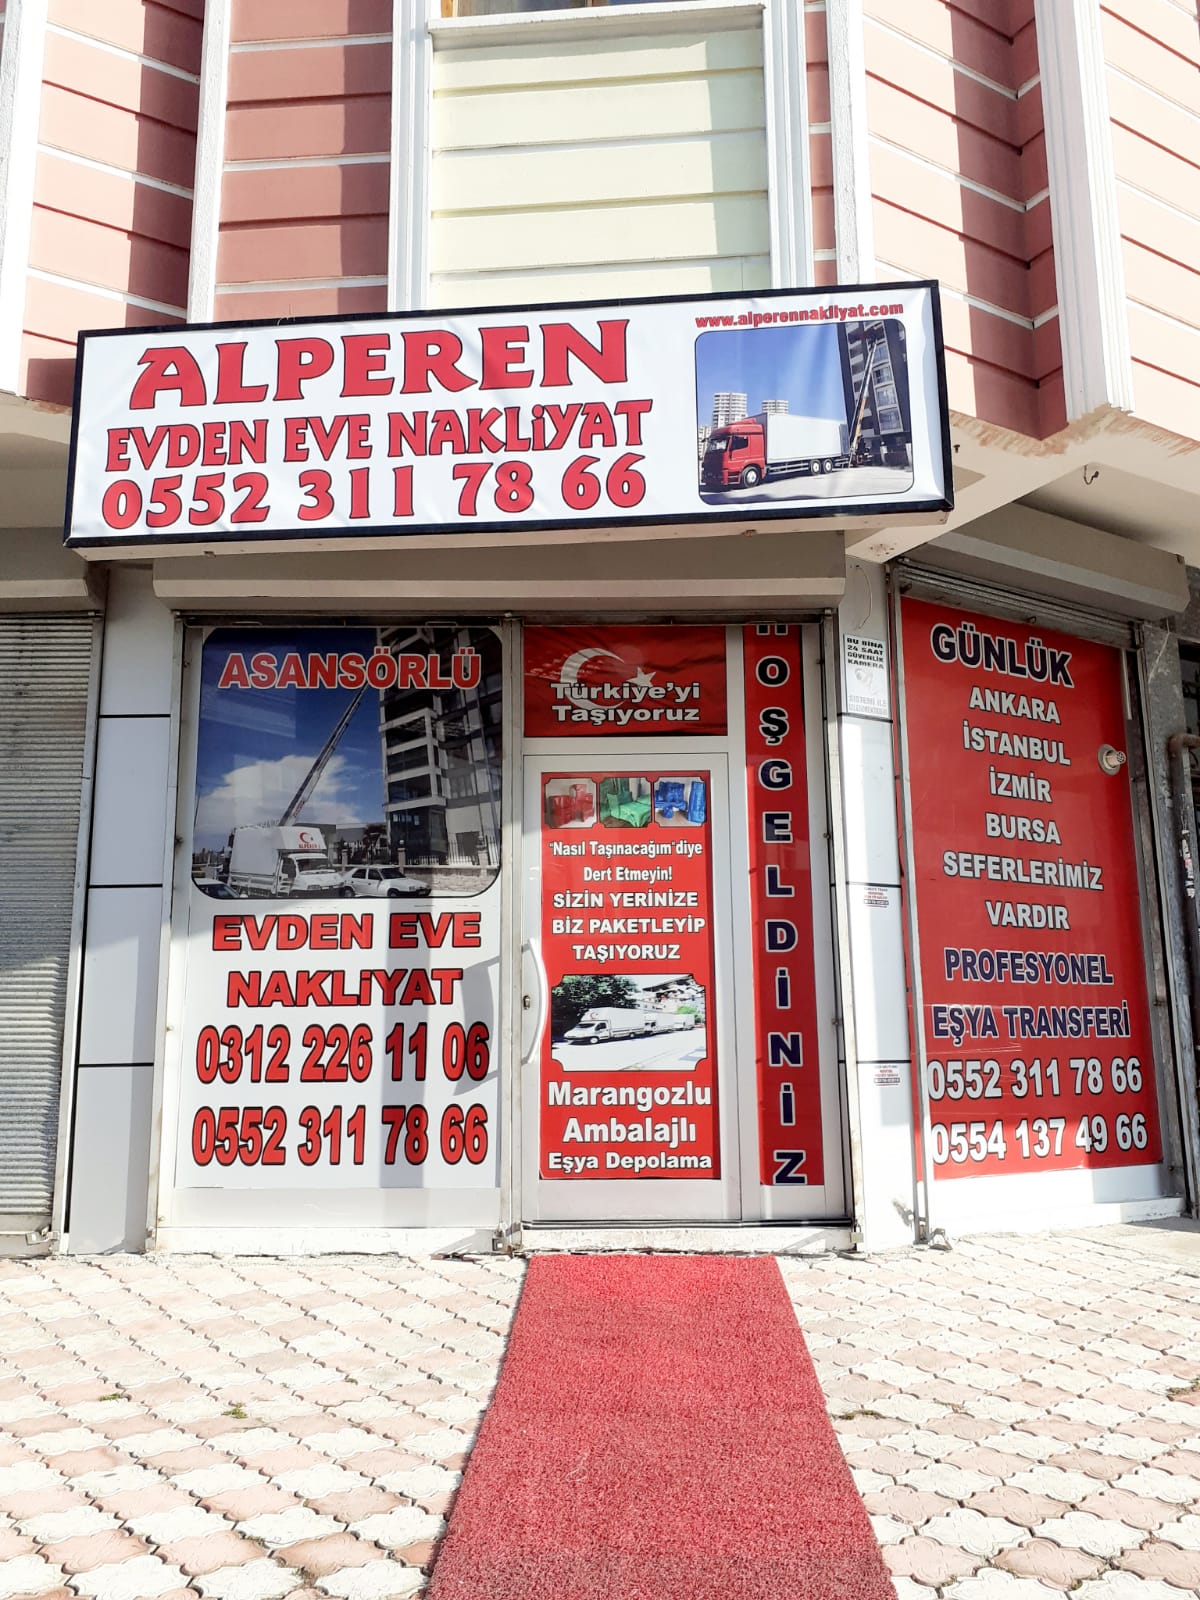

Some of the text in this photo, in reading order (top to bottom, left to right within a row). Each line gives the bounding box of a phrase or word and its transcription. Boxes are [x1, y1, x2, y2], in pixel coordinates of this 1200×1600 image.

[695, 304, 904, 328] www.alperennakliyat.com
[129, 319, 630, 410] ALPEREN
[105, 419, 269, 472] EVDEN
[283, 413, 374, 463] EVE
[101, 454, 646, 530] 0552 311 78 66
[218, 646, 482, 690] ASANSÖRLÜ
[930, 621, 1075, 688] GÜNLÜK
[550, 682, 700, 703] Türkiye'yi
[969, 686, 1061, 724] ANKARA
[551, 705, 700, 725] Taşıyoruz
[962, 720, 1071, 765] İSTANBUL
[989, 766, 1052, 803] İZMİR
[985, 812, 1061, 844] BURSA
[583, 866, 672, 884] Dert Etmeyin!
[942, 851, 1104, 890] SEFERLERİMİZ
[553, 889, 698, 908] SİZİN YERİNİZE
[985, 900, 1070, 930] VARDIR
[212, 912, 482, 951] EVDEN EVE
[552, 914, 705, 934] BİZ PAKETLEYİP
[572, 944, 681, 963] TAŞIYORUZ
[944, 947, 1114, 985] PROFESYONEL
[932, 1000, 1131, 1047] EŞYA TRANSFERİ
[196, 1021, 490, 1084] 0312 226 11 06
[548, 1081, 712, 1112] Marangozlu
[927, 1059, 1002, 1100] 0552
[1010, 1058, 1060, 1097] 311
[1070, 1058, 1103, 1095] 78
[1111, 1057, 1142, 1093] 66
[192, 1103, 488, 1166] 0552 311 78 66
[562, 1117, 696, 1149] Ambalajlı
[931, 1113, 1147, 1164] 0554 137 49 66
[548, 1152, 712, 1174] Eşya Depolama
